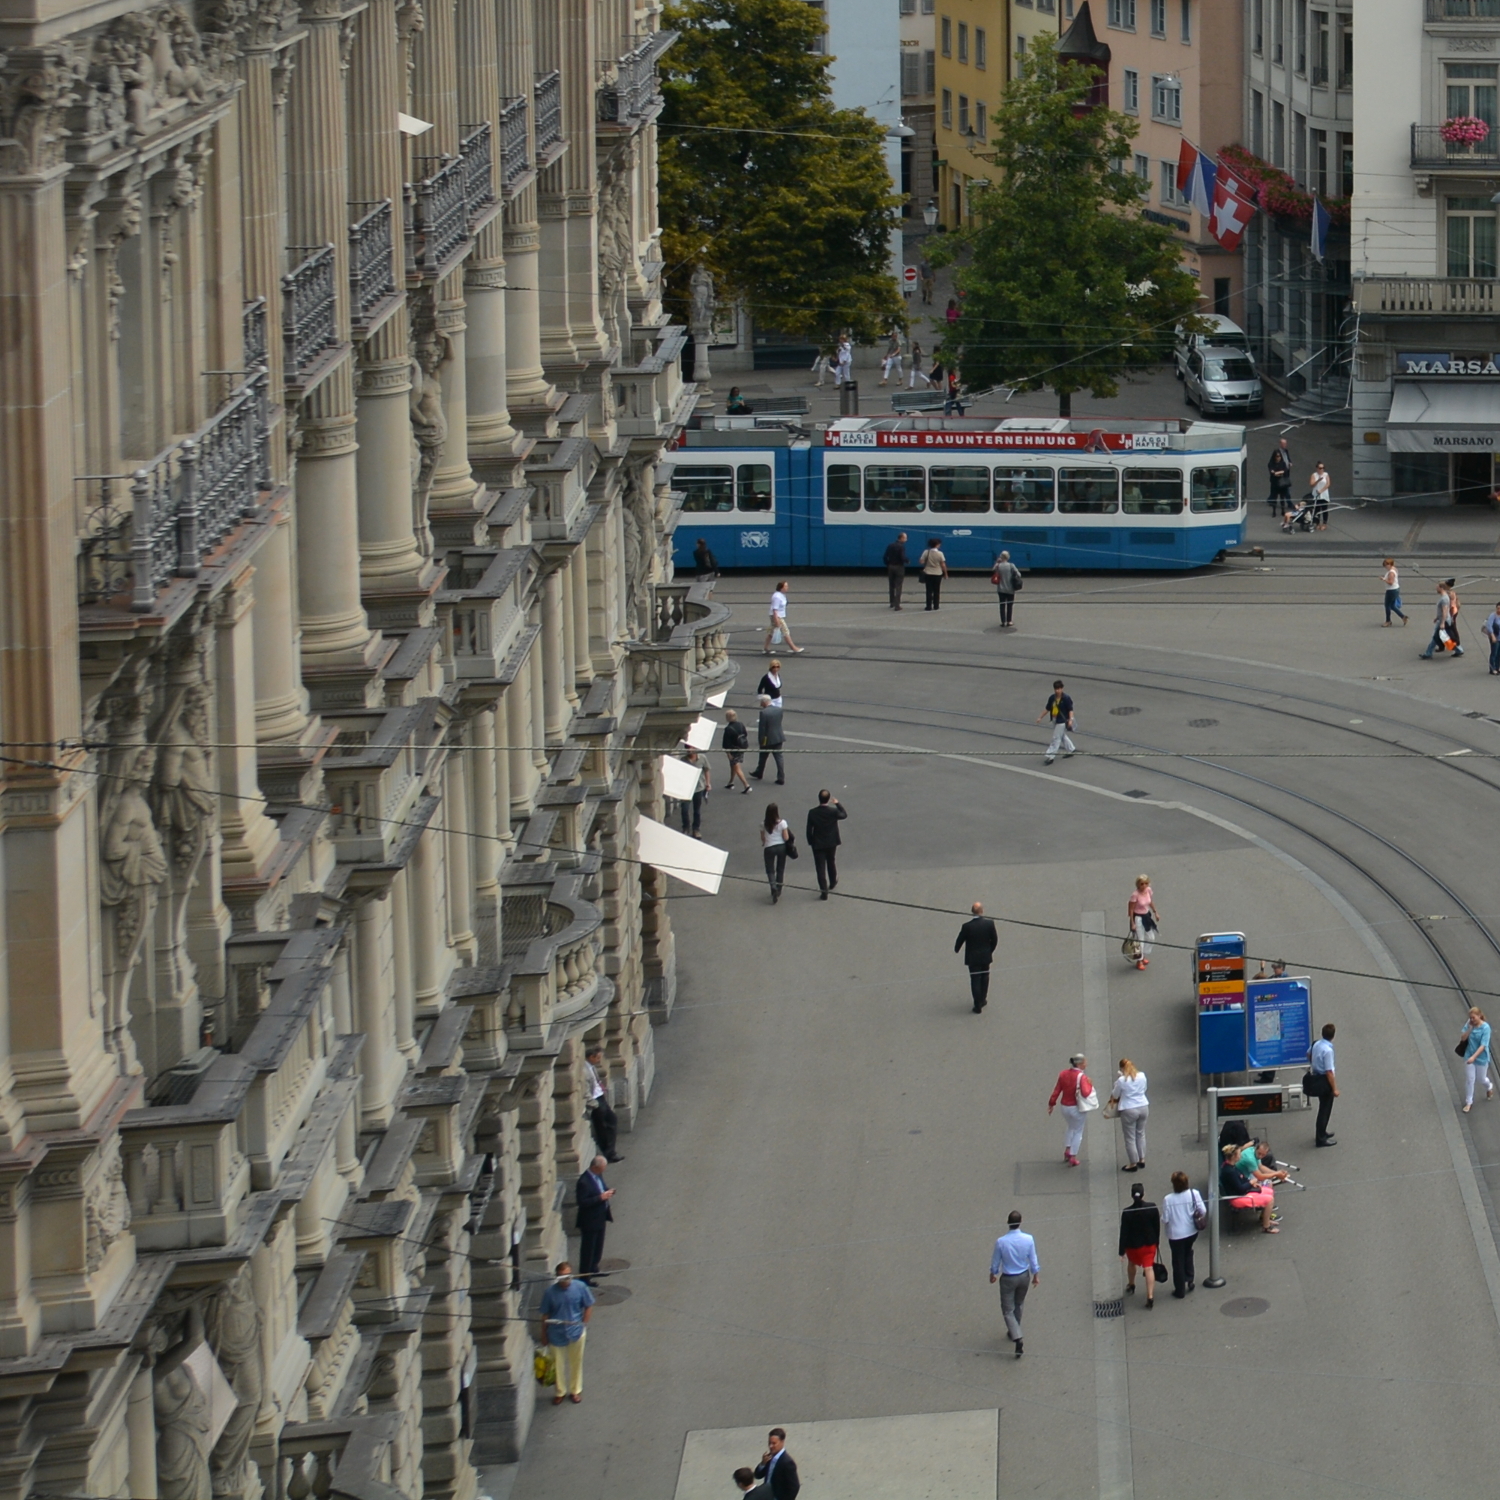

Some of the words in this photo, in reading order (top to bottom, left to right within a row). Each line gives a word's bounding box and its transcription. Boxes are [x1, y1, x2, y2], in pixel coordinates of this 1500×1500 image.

[883, 434, 919, 444] IHRE
[925, 434, 1077, 446] BAUUNTERNEHMUNG
[1433, 436, 1494, 446] MARSANO
[1202, 997, 1211, 1005] 17
